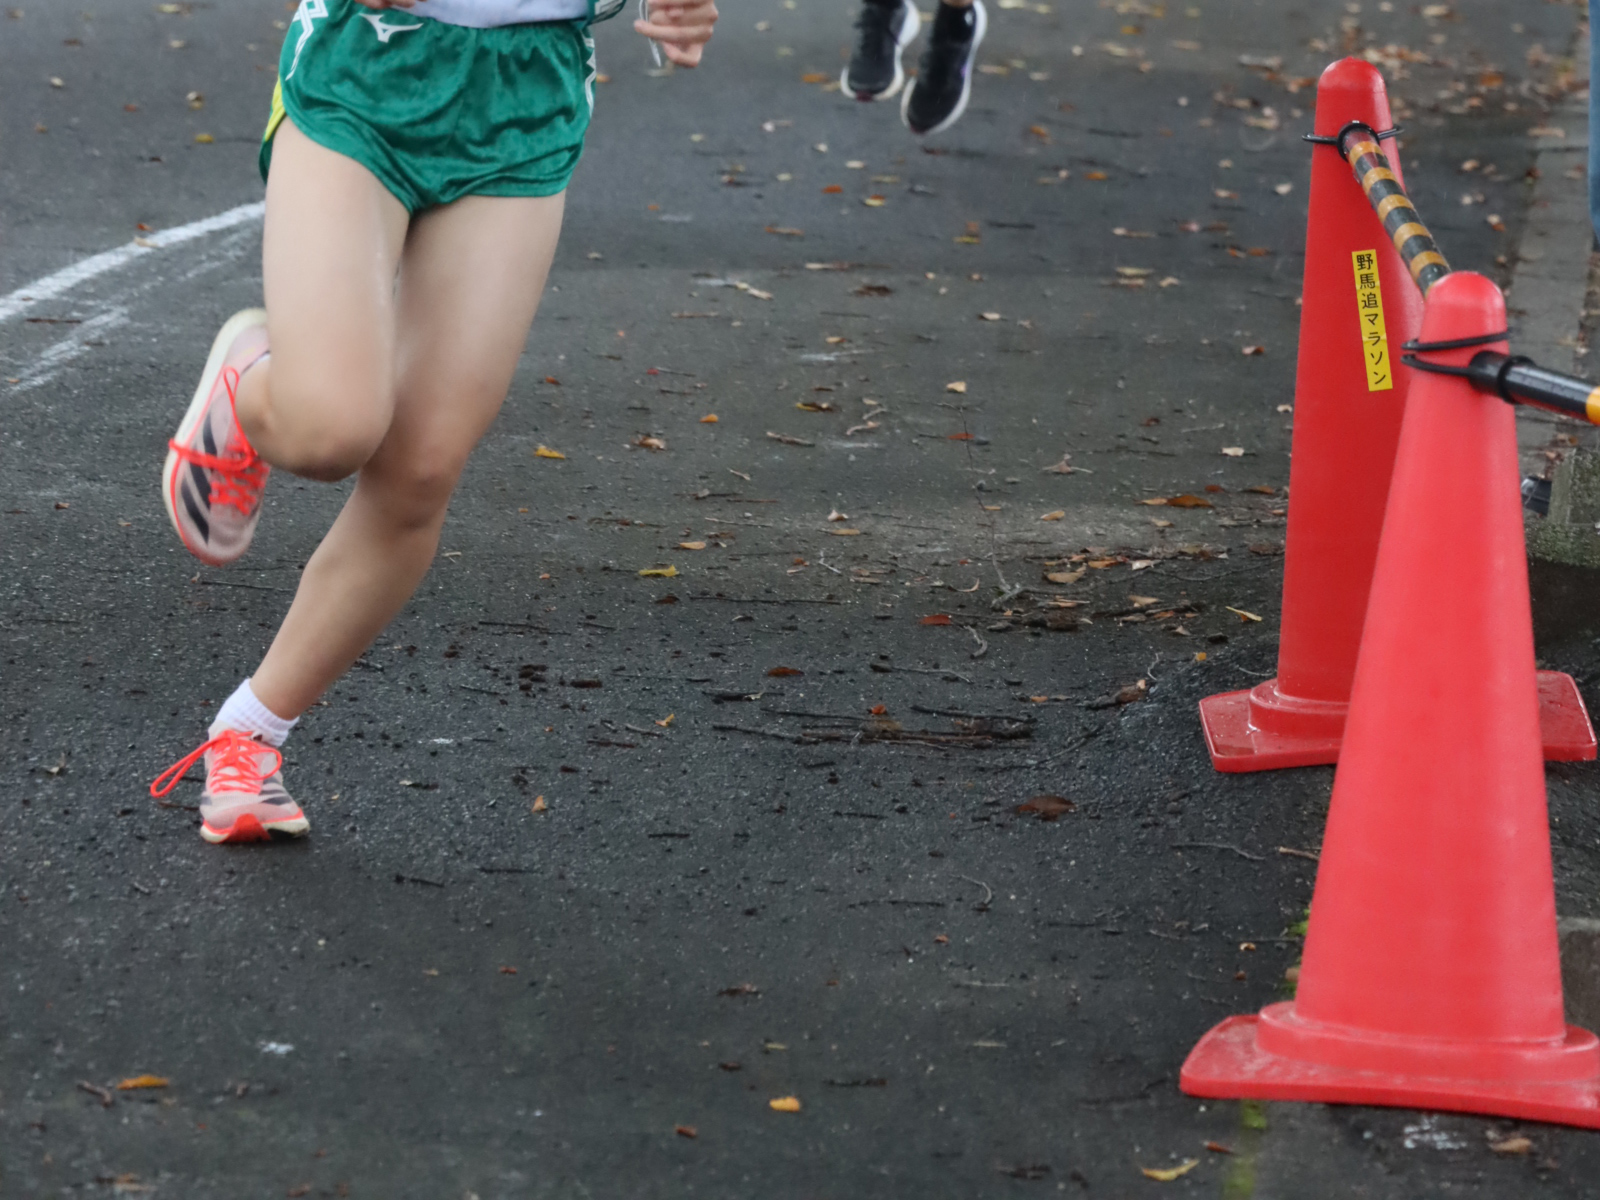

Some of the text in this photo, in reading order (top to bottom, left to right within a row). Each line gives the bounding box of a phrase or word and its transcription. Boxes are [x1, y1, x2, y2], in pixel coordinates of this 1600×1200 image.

[1356, 253, 1387, 385] 野馬追マラソン
